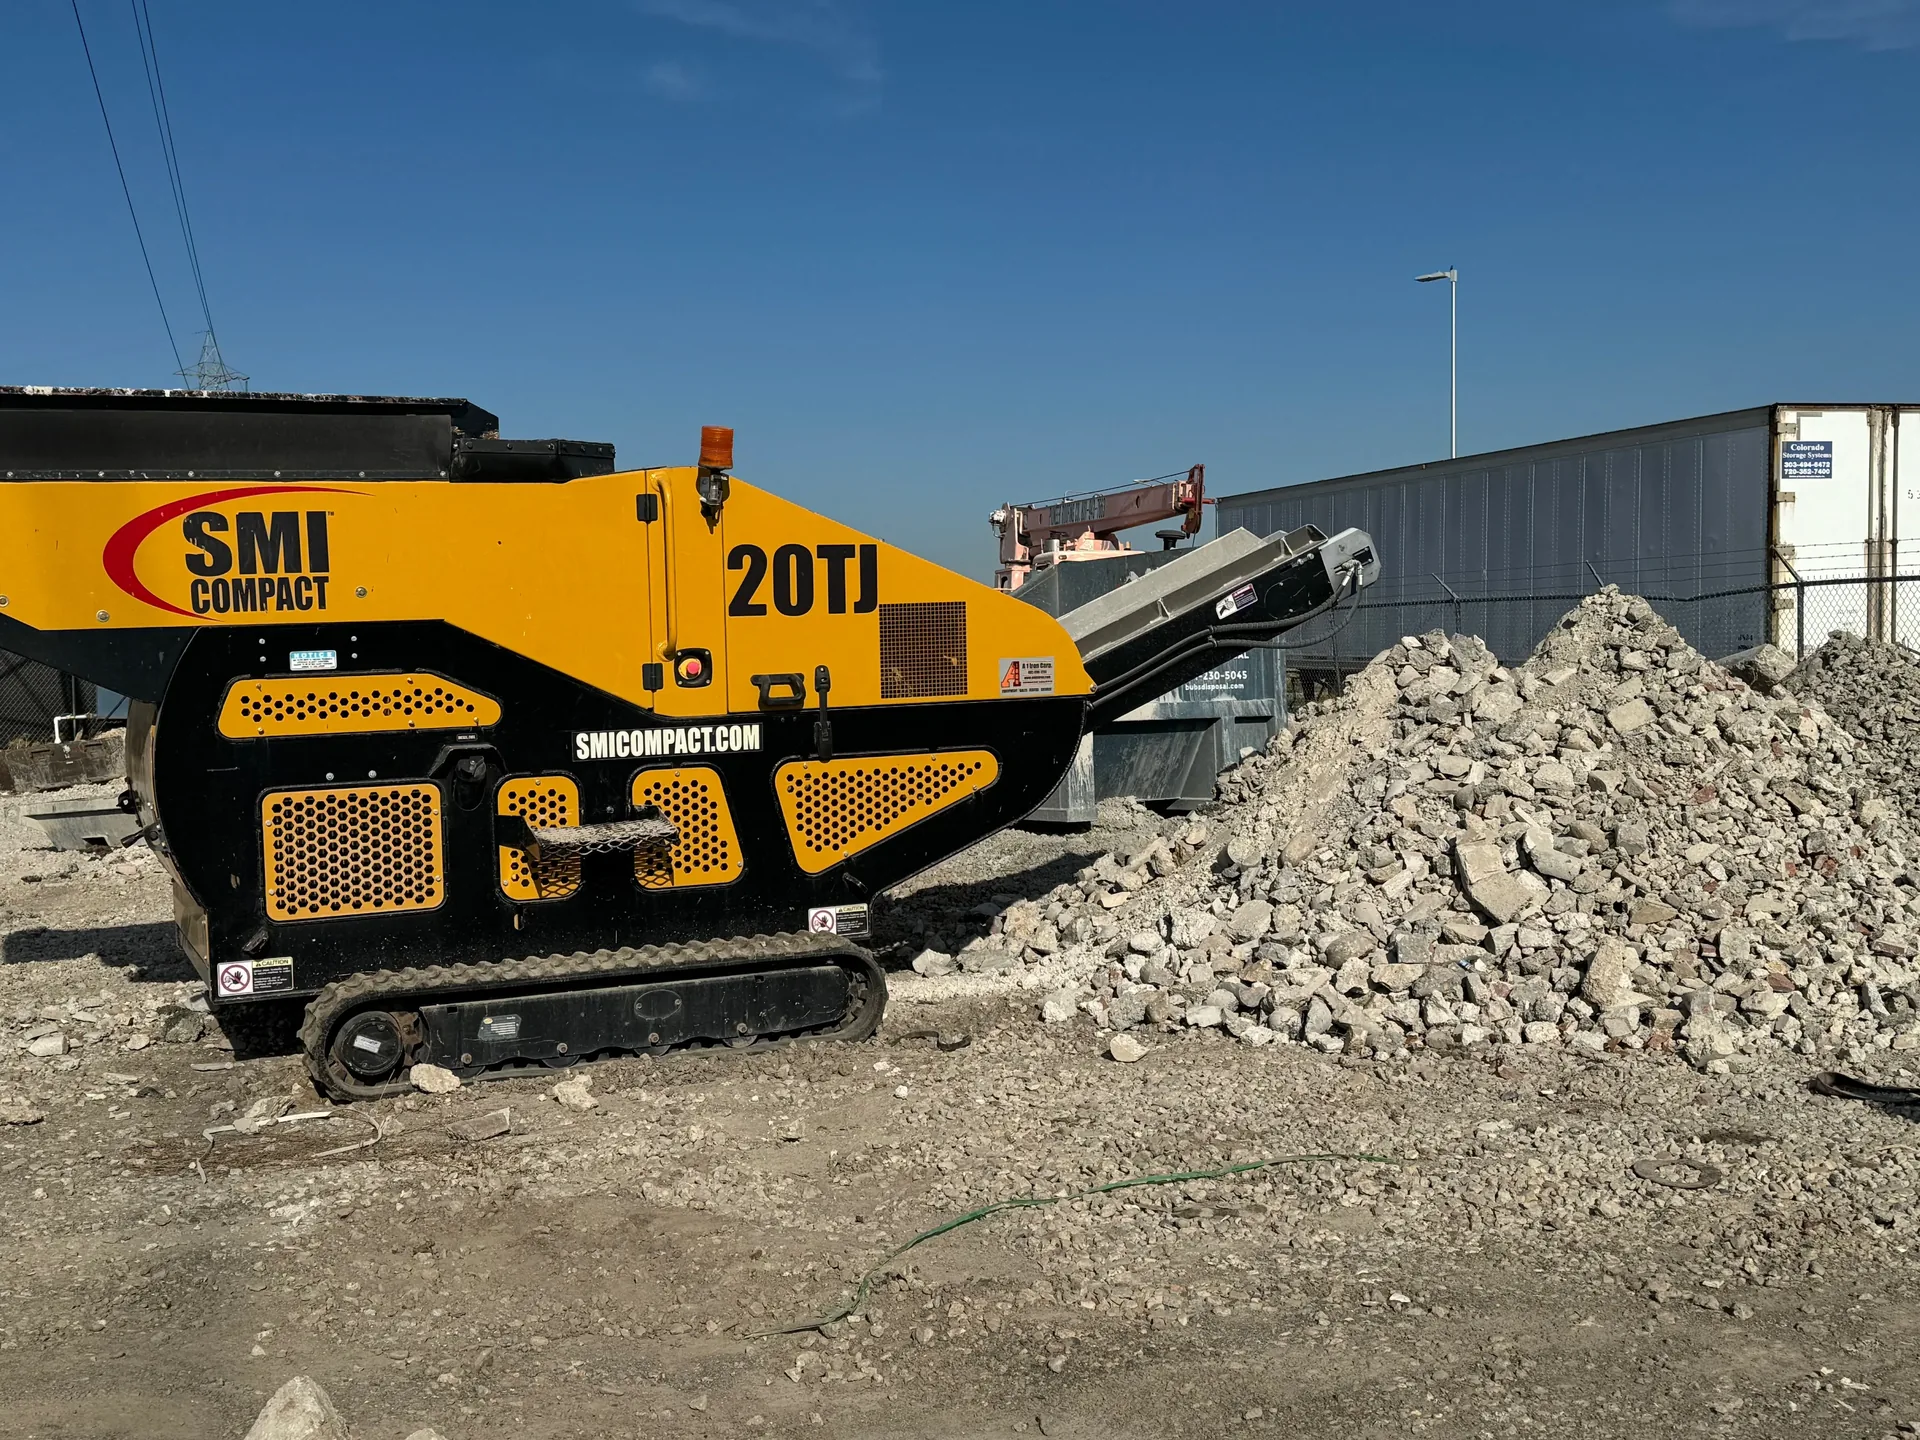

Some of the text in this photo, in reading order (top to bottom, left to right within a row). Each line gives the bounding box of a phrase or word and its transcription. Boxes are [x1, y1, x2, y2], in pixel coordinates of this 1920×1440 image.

[1782, 452, 1806, 460] Storage
[1790, 443, 1825, 451] Colorado
[183, 511, 330, 577] SMI
[727, 543, 878, 617] 20TJ
[190, 576, 330, 614] COMPACT
[1184, 682, 1245, 691] bubsdisposal.com
[575, 724, 760, 760] SMICOMPACT.COM
[261, 959, 289, 967] CAUTION
